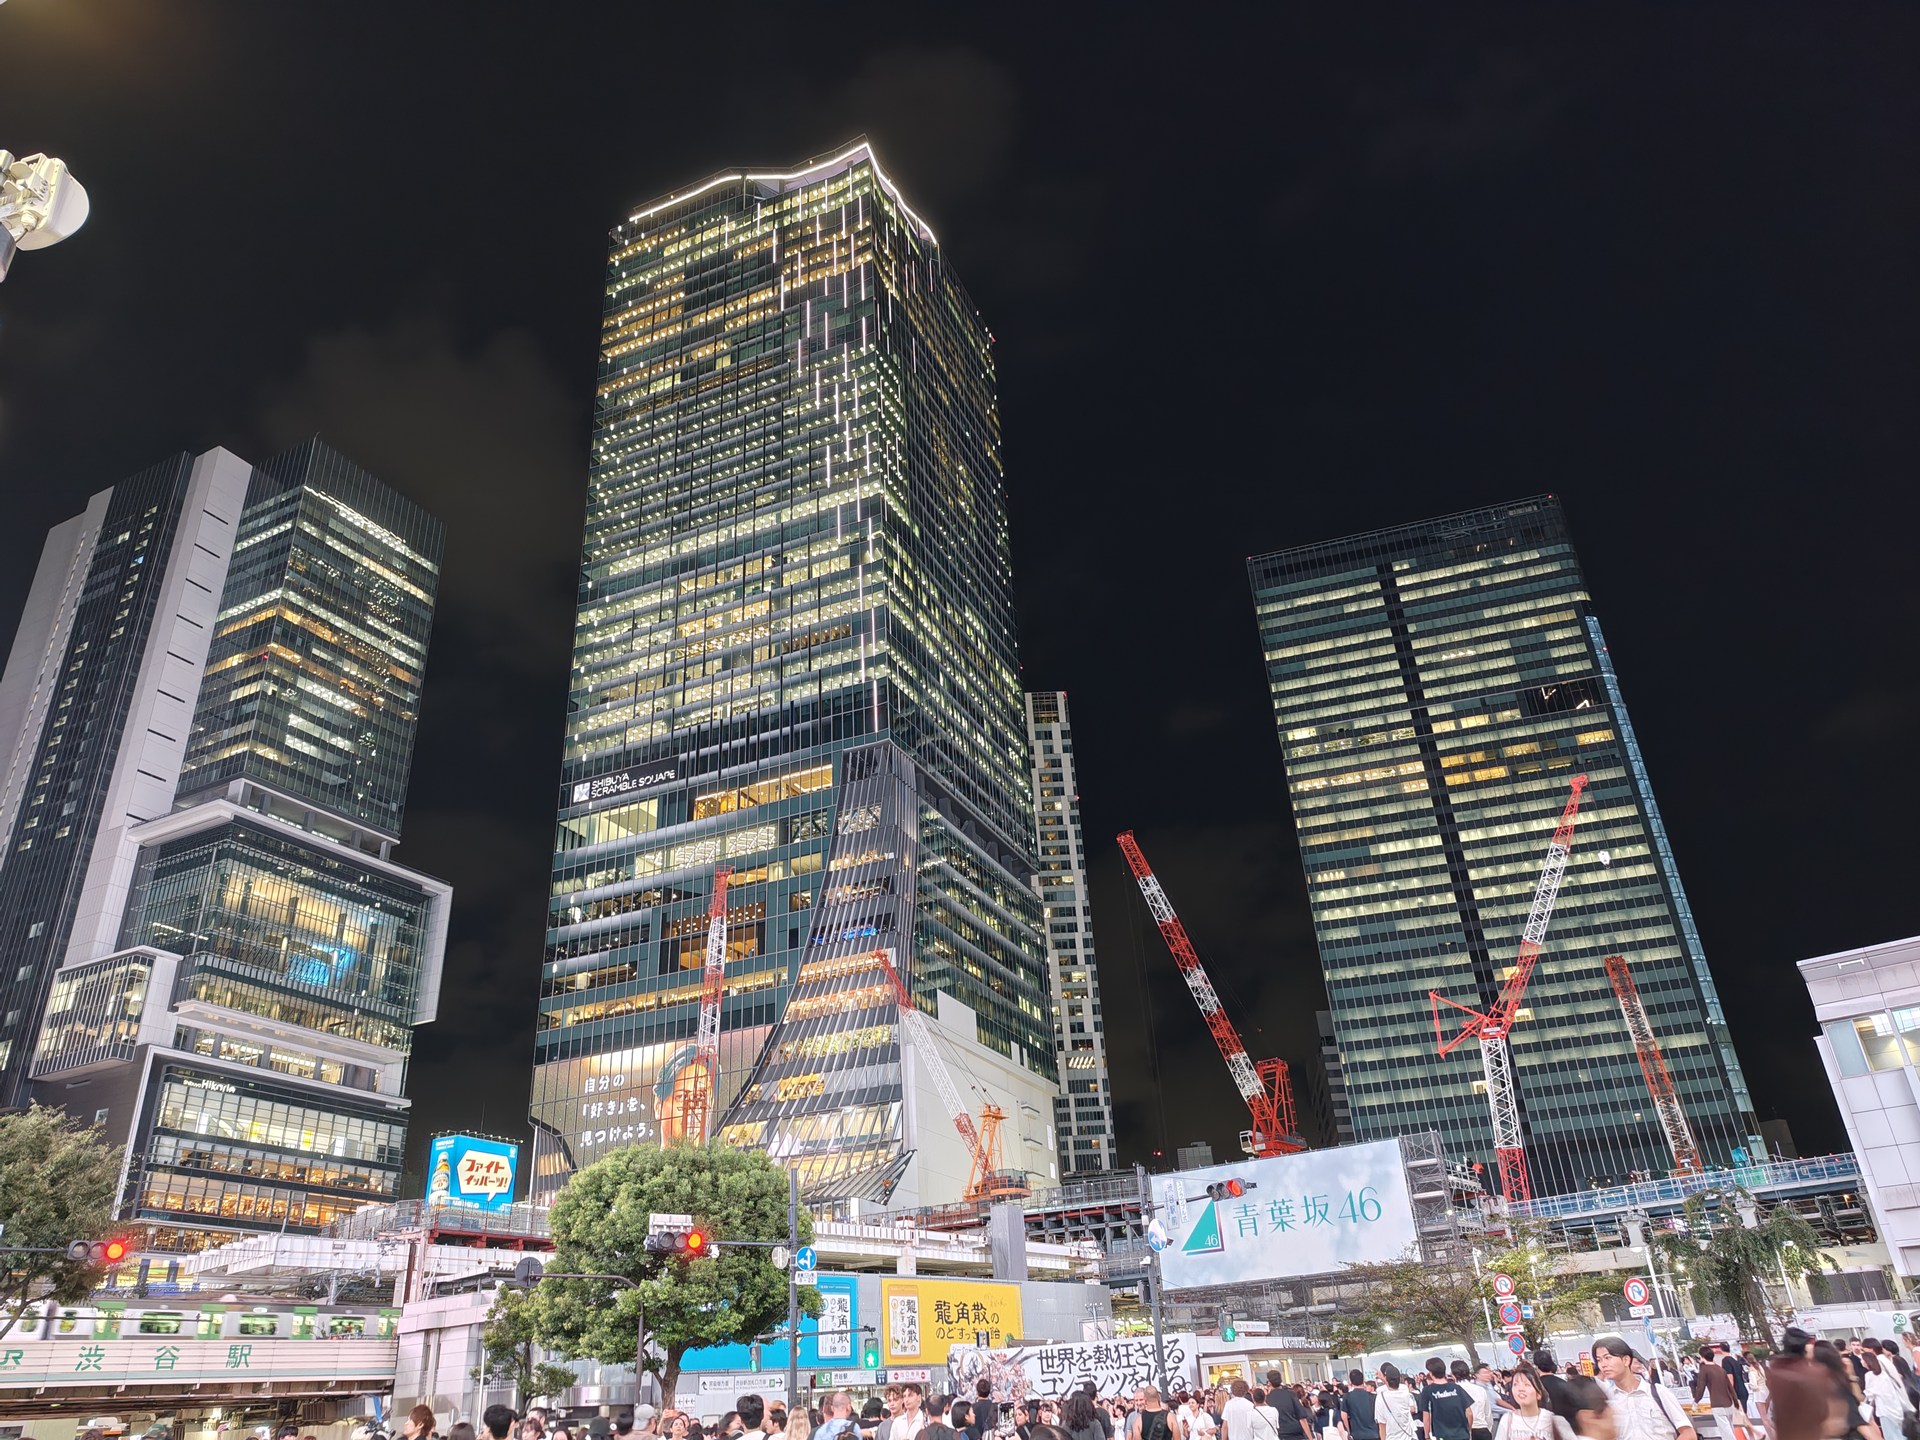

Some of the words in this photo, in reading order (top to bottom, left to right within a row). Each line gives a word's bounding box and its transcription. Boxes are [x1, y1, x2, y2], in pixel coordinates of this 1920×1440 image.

[590, 779, 637, 799] SCRAMBLE
[638, 769, 676, 787] SQUARE
[591, 772, 630, 790] SHIBUYA
[201, 1079, 236, 1094] Hikarie
[584, 1074, 625, 1094] 自分の
[582, 1096, 646, 1119] 「好き」を、
[580, 1122, 654, 1148] 見つけよう。
[465, 1158, 505, 1174] ファイト
[1232, 1186, 1382, 1238] 青葉坂46
[1204, 1233, 1219, 1247] 46
[934, 1300, 1000, 1326] 龍角散の
[1893, 1314, 1906, 1325] 29
[75, 1344, 252, 1372] 渋谷駅
[1037, 1338, 1186, 1376] 世界を熱狂させる
[821, 1373, 831, 1381] JR
[833, 1372, 848, 1380] 渋谷駅
